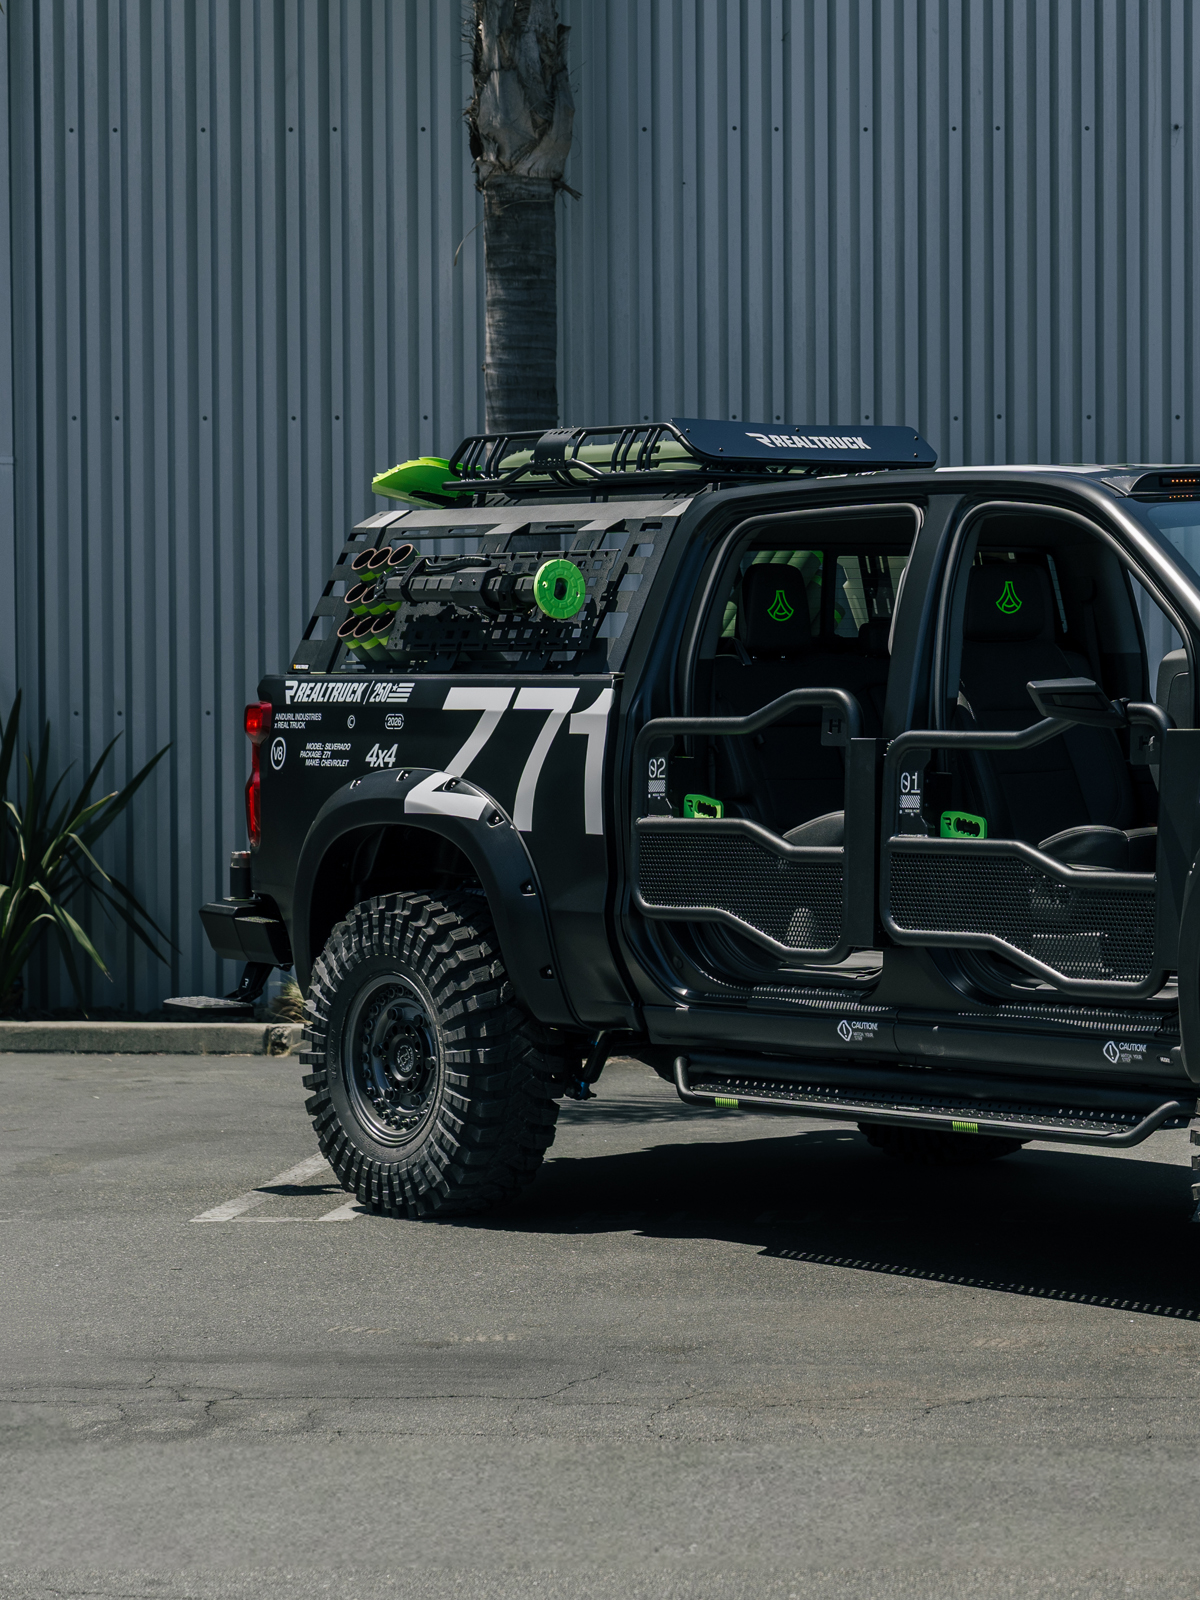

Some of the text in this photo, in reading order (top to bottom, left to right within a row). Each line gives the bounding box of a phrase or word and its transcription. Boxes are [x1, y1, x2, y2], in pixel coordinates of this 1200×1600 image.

[765, 434, 871, 449] REALTRUCK
[294, 682, 369, 703] REALTRUCK
[369, 682, 391, 702] 250
[274, 713, 322, 721] ANDURIL INDUSTRIES
[387, 717, 402, 726] 2026
[273, 746, 283, 760] V8
[324, 743, 351, 751] SILVERADO
[365, 743, 398, 768] 4x4
[320, 759, 349, 767] CHEVROLET
[648, 758, 666, 778] 02
[900, 772, 920, 793] 01
